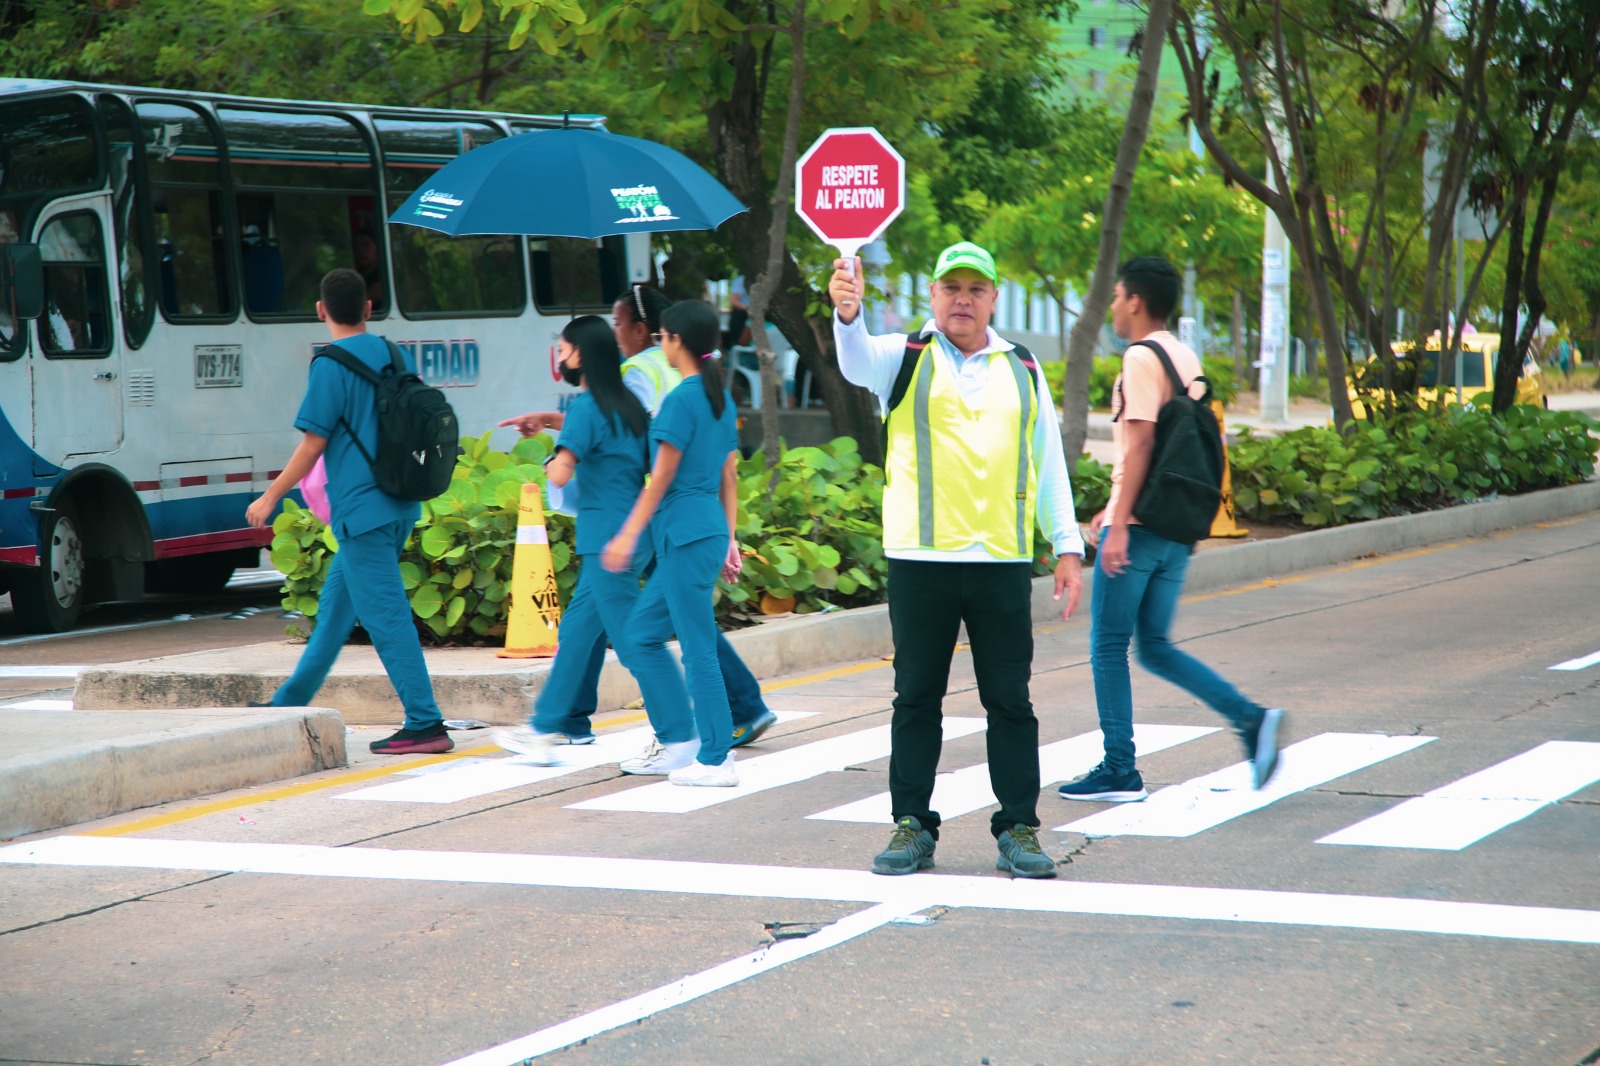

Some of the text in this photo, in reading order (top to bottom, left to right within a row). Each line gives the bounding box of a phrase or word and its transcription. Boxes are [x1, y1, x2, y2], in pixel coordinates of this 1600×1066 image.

[822, 165, 878, 186] RESPETE
[815, 188, 885, 209] AL PEATON
